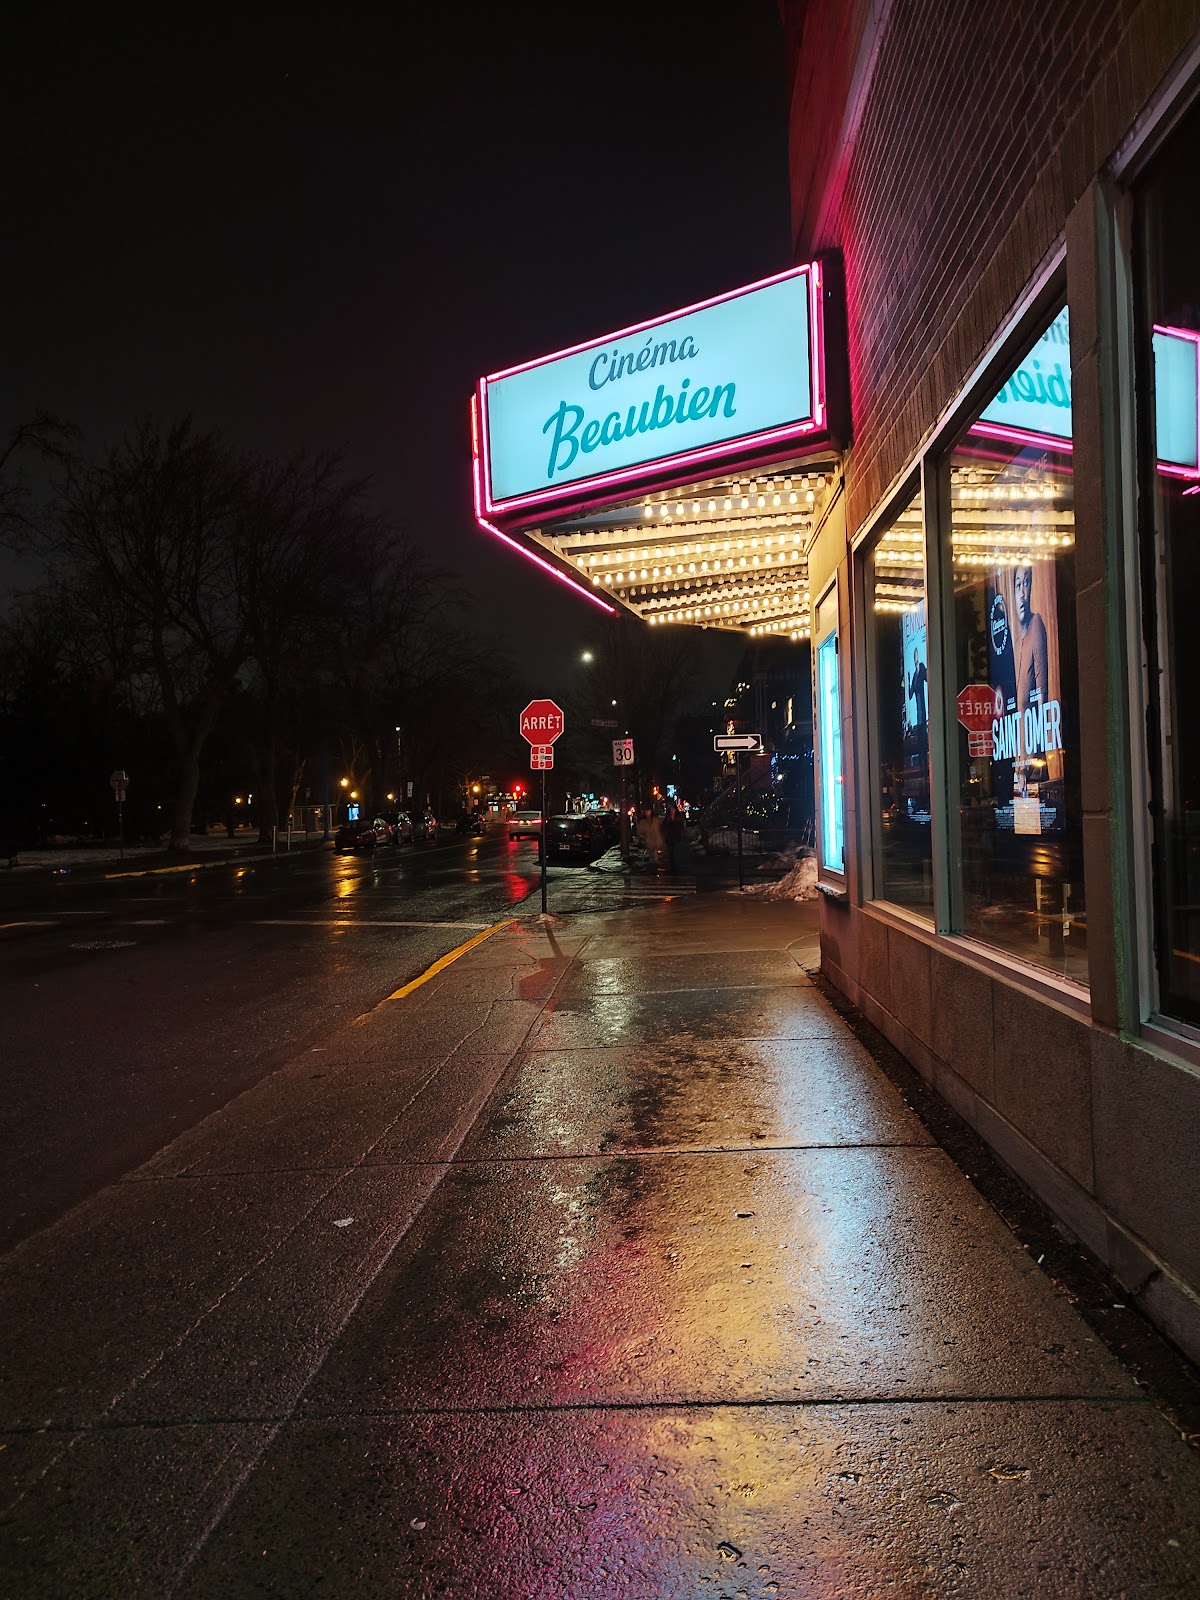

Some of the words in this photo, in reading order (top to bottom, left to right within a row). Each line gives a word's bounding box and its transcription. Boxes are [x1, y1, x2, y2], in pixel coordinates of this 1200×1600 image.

[588, 335, 700, 391] Cinéma
[542, 378, 737, 479] Beaubien
[523, 713, 561, 730] ARRÊT
[992, 711, 1022, 762] SAINT
[1024, 700, 1062, 754] OMER
[615, 747, 632, 762] 30
